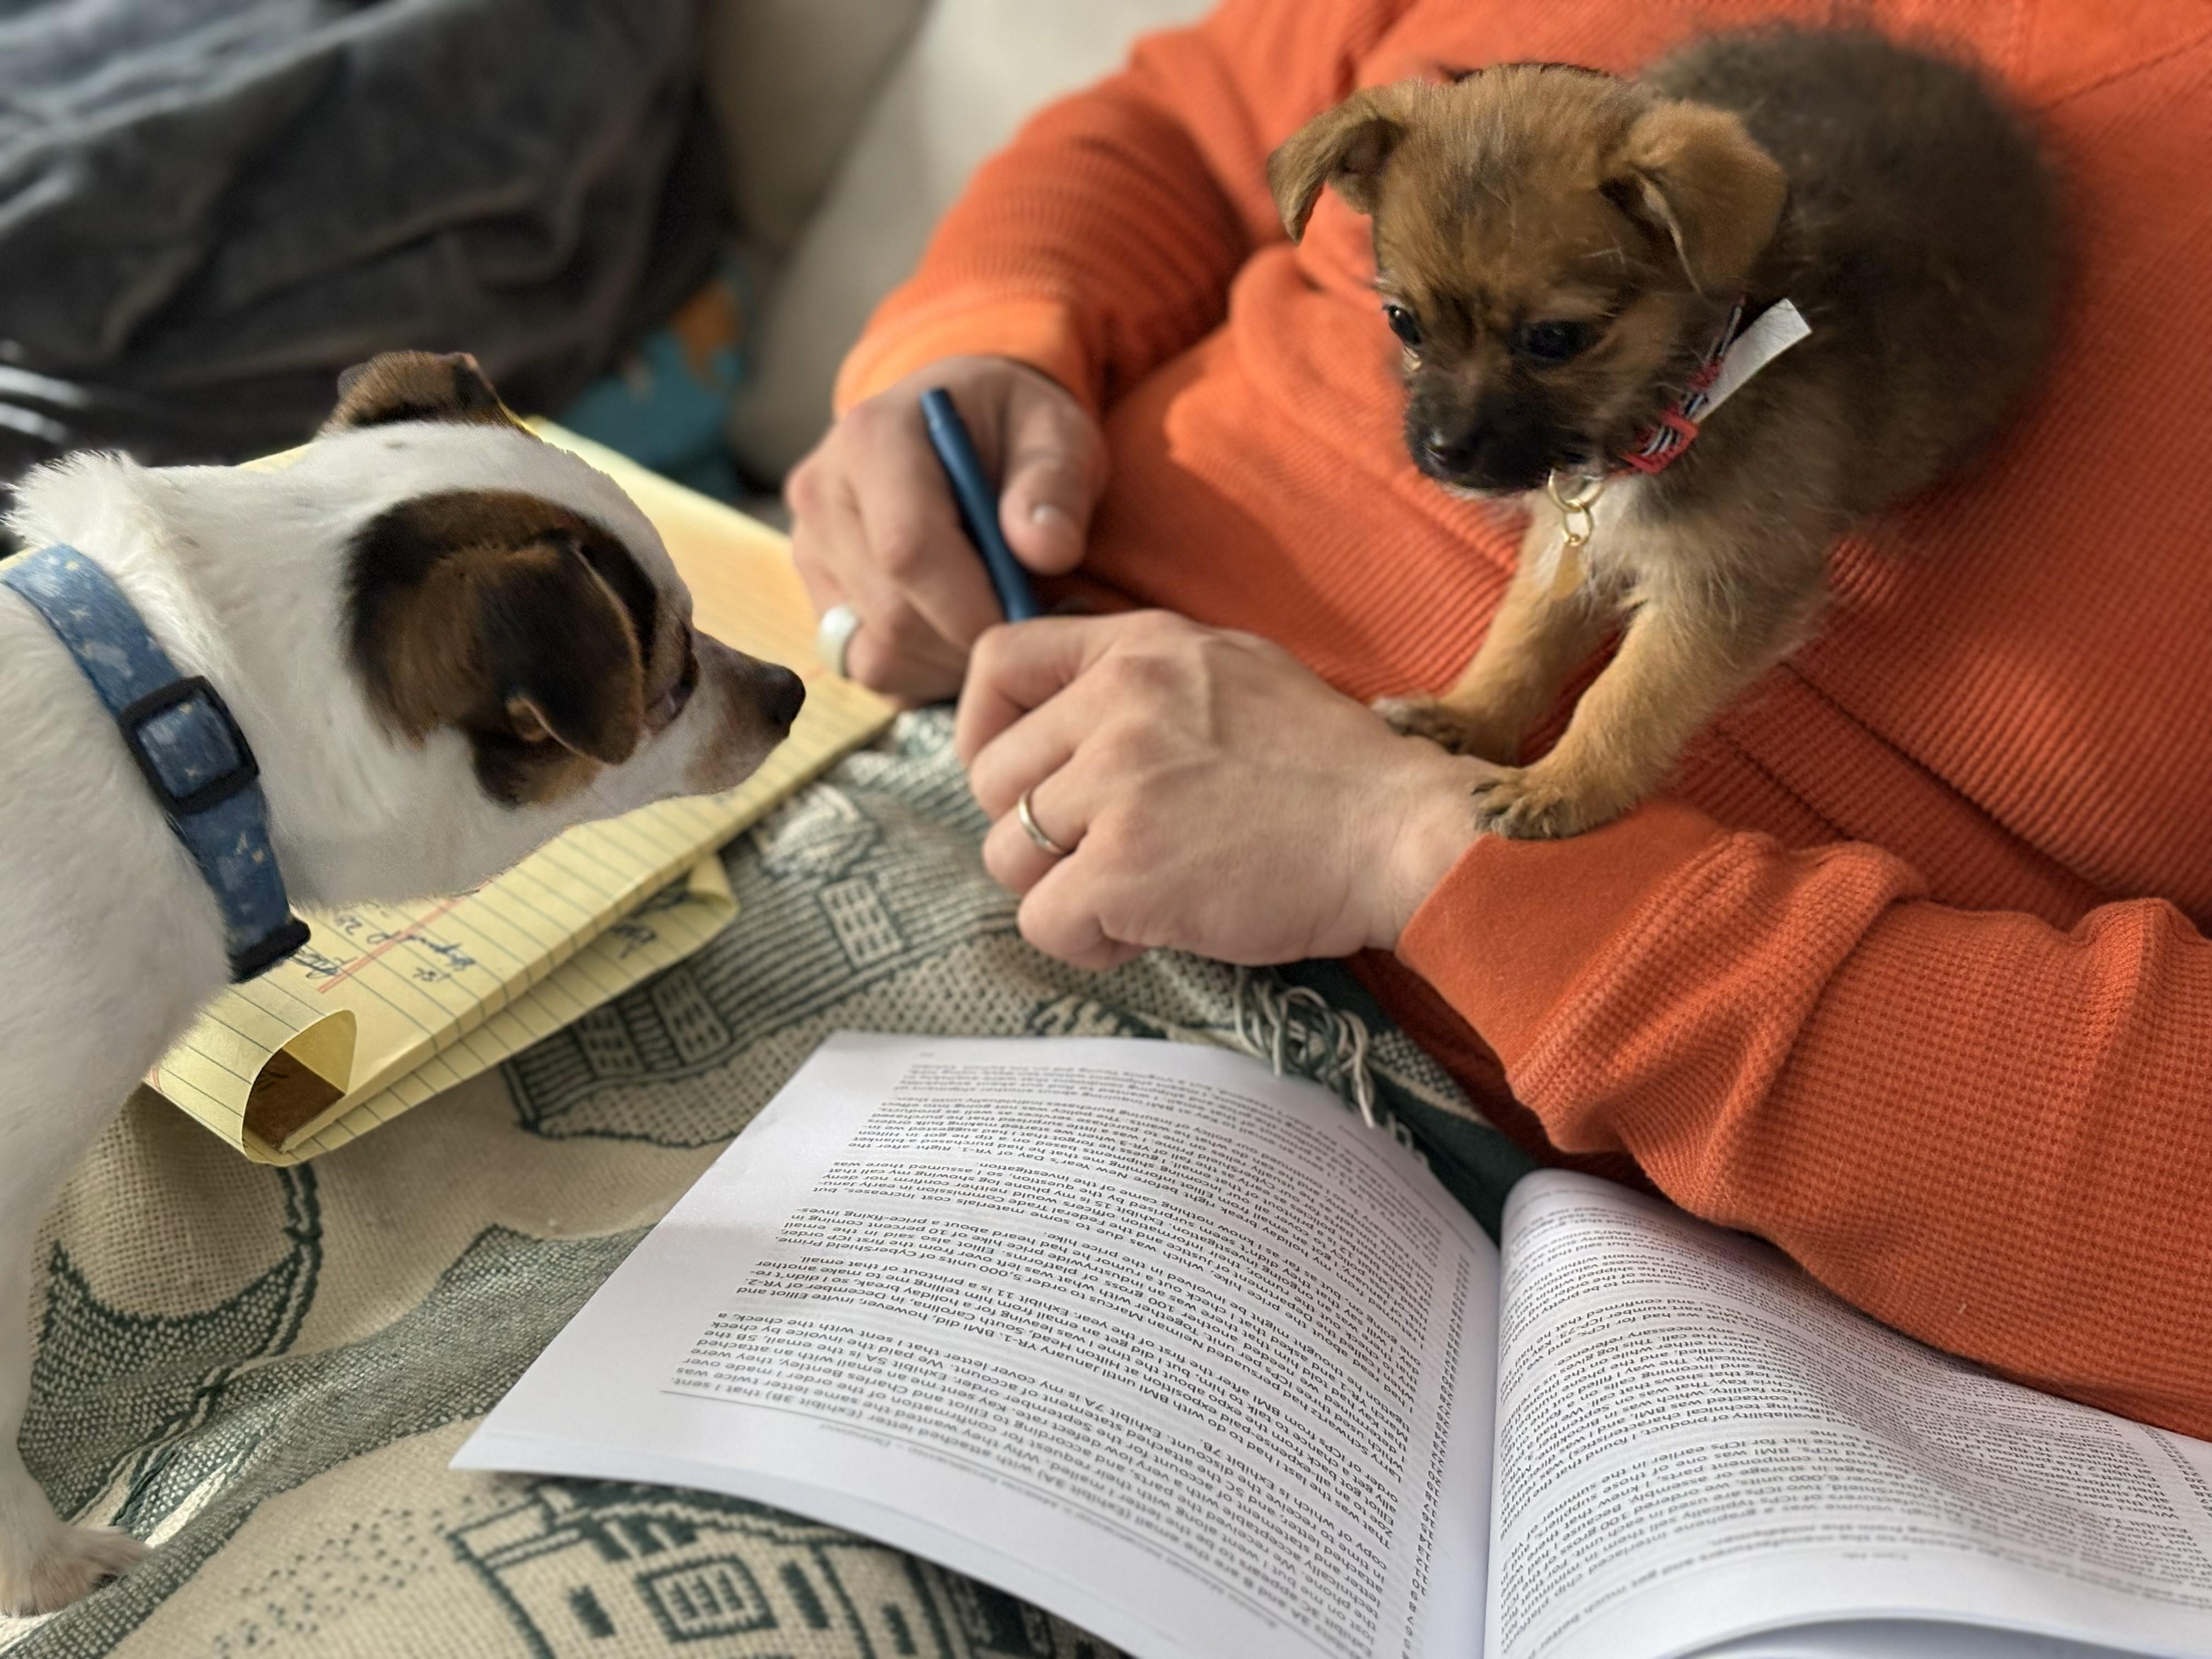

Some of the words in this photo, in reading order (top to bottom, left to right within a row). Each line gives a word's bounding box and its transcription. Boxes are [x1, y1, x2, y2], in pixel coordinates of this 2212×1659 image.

[913, 1170, 975, 1182] showing
[978, 1176, 1001, 1186] log
[916, 1186, 1005, 1203] Commission
[1003, 1181, 1051, 1194] phone
[1053, 1190, 1076, 1199] my
[1008, 1198, 1048, 1212] Trade
[1079, 1196, 1091, 1204] is
[1094, 1200, 1112, 1209] 15
[807, 1216, 864, 1226] coming
[1051, 1207, 1105, 1226] Federal
[1116, 1205, 1164, 1227] Exhibit
[867, 1222, 926, 1232] percent
[1108, 1222, 1132, 1234] the
[855, 1237, 885, 1245] first
[888, 1240, 914, 1248] the
[971, 1235, 1003, 1247] hike
[1135, 1231, 1164, 1244] and
[918, 1243, 954, 1255] from
[1006, 1242, 1045, 1256] price
[1166, 1242, 1214, 1266] Justice
[1168, 1223, 1259, 1269] investigation.
[799, 1256, 844, 1265] email.
[957, 1251, 992, 1262] over
[847, 1261, 878, 1270] that
[995, 1259, 1021, 1271] left
[1024, 1266, 1053, 1279] was
[1047, 1252, 1144, 1289] industrywide
[1214, 1263, 1230, 1273] of
[745, 1278, 782, 1288] YR-2.
[902, 1267, 964, 1285] printout
[1057, 1274, 1094, 1291] what
[1261, 1265, 1314, 1300] ongoing
[804, 1284, 887, 1300] December
[980, 1285, 992, 1294] is
[997, 1289, 1015, 1300] 11
[1098, 1288, 1131, 1305] with
[1148, 1285, 1166, 1297] an
[1232, 1270, 1313, 1322] Department
[890, 1295, 905, 1304] in
[1018, 1295, 1069, 1317] Exhibit
[1168, 1295, 1197, 1312] was
[1317, 1299, 1332, 1313] an
[909, 1298, 975, 1321] Carolina,
[1586, 1299, 1662, 1319] confirmed
[1606, 1305, 1667, 1319] number
[1642, 1312, 1671, 1321] had
[979, 1316, 1024, 1335] South
[1074, 1312, 1108, 1329] year.
[1133, 1302, 1199, 1336] Together
[1200, 1309, 1238, 1333] there
[1335, 1312, 1358, 1334] was
[1555, 1316, 1583, 1332] that
[1615, 1316, 1636, 1325] for
[1111, 1325, 1135, 1341] the
[1316, 1320, 1337, 1339] the
[1559, 1316, 1602, 1339] ICP-73.
[1577, 1323, 1610, 1336] ICPs,
[1627, 1326, 1703, 1339] necessary
[1029, 1329, 1072, 1351] Head,
[1137, 1338, 1155, 1347] of
[1203, 1331, 1235, 1352] unit.
[1242, 1329, 1270, 1350] that
[1623, 1338, 1653, 1348] This
[1657, 1334, 1688, 1342] call.
[1158, 1345, 1186, 1364] first
[1339, 1336, 1375, 1367] called
[1361, 1332, 1392, 1362] there
[1547, 1337, 1571, 1356] and
[1075, 1346, 1120, 1370] Hilton
[1237, 1351, 1262, 1368] per
[1273, 1348, 1299, 1370] him
[1124, 1365, 1139, 1376] at
[1189, 1360, 1213, 1377] the
[1376, 1366, 1381, 1374] I
[1395, 1361, 1418, 1385] that
[1641, 1364, 1713, 1379] incoming
[1265, 1365, 1293, 1389] ICPs
[1302, 1367, 1328, 1389] told
[1654, 1373, 1703, 1385] shows
[1143, 1373, 1217, 1414] exposition
[1216, 1375, 1250, 1397] after
[1383, 1372, 1414, 1404] when
[1619, 1381, 1650, 1395] that
[1638, 1387, 1669, 1398] was
[1674, 1381, 1711, 1391] That
[1295, 1386, 1331, 1414] three
[1330, 1386, 1355, 1410] had
[1615, 1395, 1634, 1406] on
[1656, 1390, 1705, 1403] which
[1670, 1399, 1702, 1409] was
[1706, 1395, 1788, 1405] contacted
[1252, 1395, 1280, 1417] BMI
[1622, 1400, 1652, 1413] was
[1629, 1406, 1666, 1420] BMI,
[1686, 1403, 1760, 1417] technical
[1357, 1408, 1379, 1429] Kay
[1604, 1410, 1617, 1419] in
[1712, 1414, 1729, 1423] of
[1284, 1414, 1316, 1440] from
[1334, 1412, 1364, 1440] used
[1640, 1415, 1708, 1435] product,
[1381, 1426, 1407, 1453] that
[1710, 1440, 1746, 1449] ICPs
[1220, 1413, 1331, 1487] all-expense-paid
[1318, 1437, 1345, 1463] ICPs
[1367, 1438, 1403, 1473] which
[1585, 1436, 1628, 1461] found
[1650, 1446, 1705, 1464] earlier
[1713, 1450, 1747, 1459] was
[1754, 1447, 1789, 1455] BMI
[1347, 1460, 1362, 1473] of
[1632, 1460, 1646, 1470] in
[1675, 1455, 1708, 1467] one
[1711, 1455, 1812, 1471] component
[1601, 1468, 1627, 1483] the
[1656, 1464, 1703, 1481] parts,
[1714, 1471, 1733, 1480] or
[1739, 1465, 1805, 1476] storage
[1363, 1473, 1398, 1503] order
[1602, 1471, 1646, 1493] those
[1334, 1486, 1351, 1503] an
[1597, 1485, 1639, 1508] knew
[1353, 1501, 1367, 1516] to
[1542, 1484, 1596, 1522] summer
[1369, 1514, 1393, 1538] Zoe
[1562, 1503, 1621, 1542] Because
[1564, 1508, 1593, 1529] that
